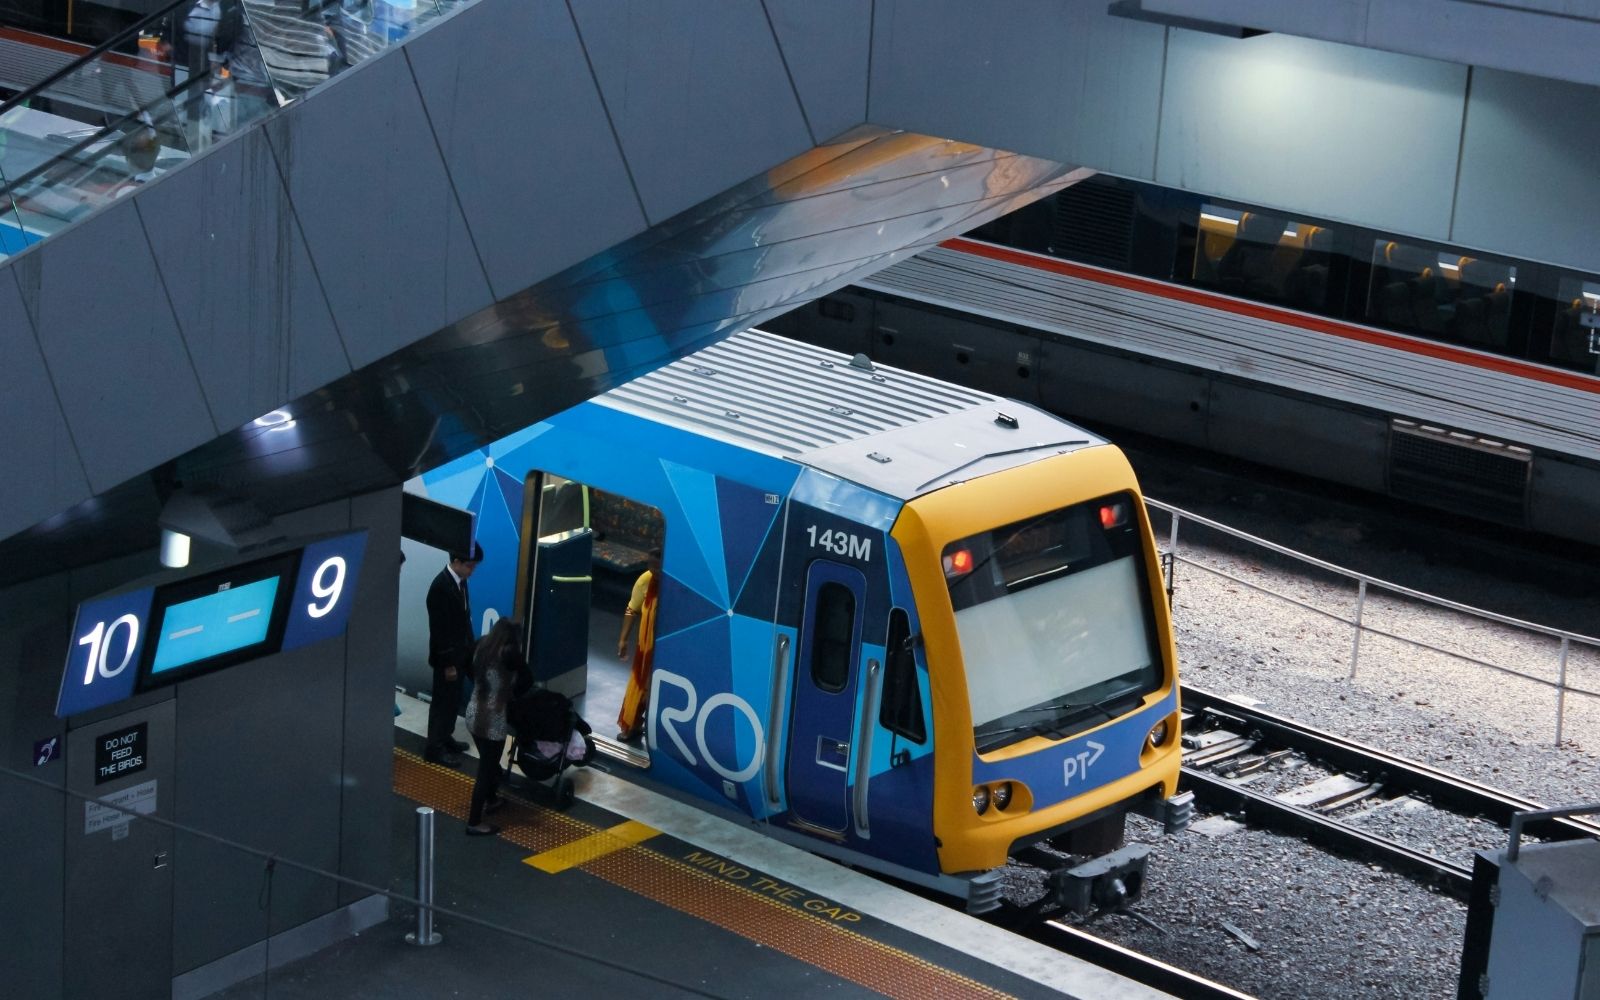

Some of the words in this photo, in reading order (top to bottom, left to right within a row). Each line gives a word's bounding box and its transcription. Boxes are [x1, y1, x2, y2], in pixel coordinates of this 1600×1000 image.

[807, 525, 872, 562] 143M
[307, 556, 346, 618] 9
[79, 613, 140, 685] 10
[105, 738, 119, 750] DO
[120, 731, 139, 745] NOT
[111, 746, 133, 761] FEED
[100, 763, 117, 777] THE
[118, 756, 143, 771] BIRDS.
[683, 851, 750, 880] MIND
[751, 876, 806, 901] THE
[803, 899, 862, 922] GAP
